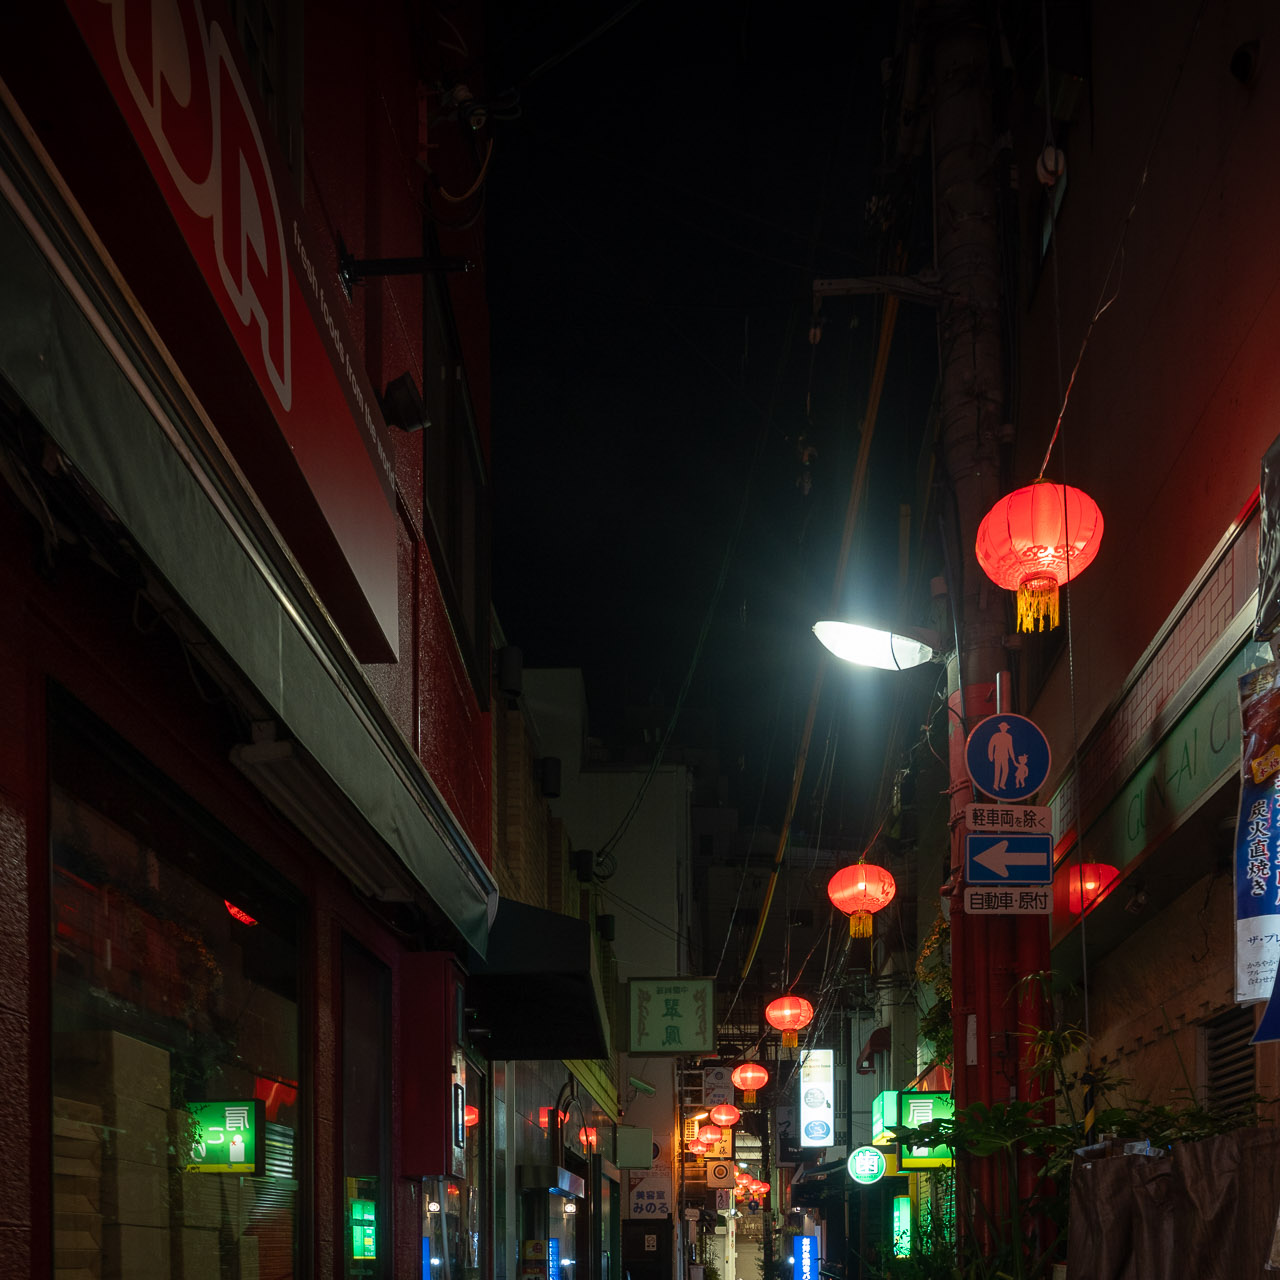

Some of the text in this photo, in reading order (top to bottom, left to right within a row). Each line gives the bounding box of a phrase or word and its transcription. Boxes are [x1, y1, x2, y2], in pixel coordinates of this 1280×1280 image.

[293, 220, 319, 298] fresh
[320, 288, 345, 363] foods
[346, 354, 364, 412] from
[364, 402, 377, 443] the
[972, 808, 1047, 828] 軽車両を除く
[1247, 800, 1271, 898] 炭火直焼き
[970, 892, 1049, 910] 自動車・原付
[854, 1150, 880, 1175] 歯
[636, 1190, 666, 1200] 美容室
[633, 1202, 669, 1214] みのる
